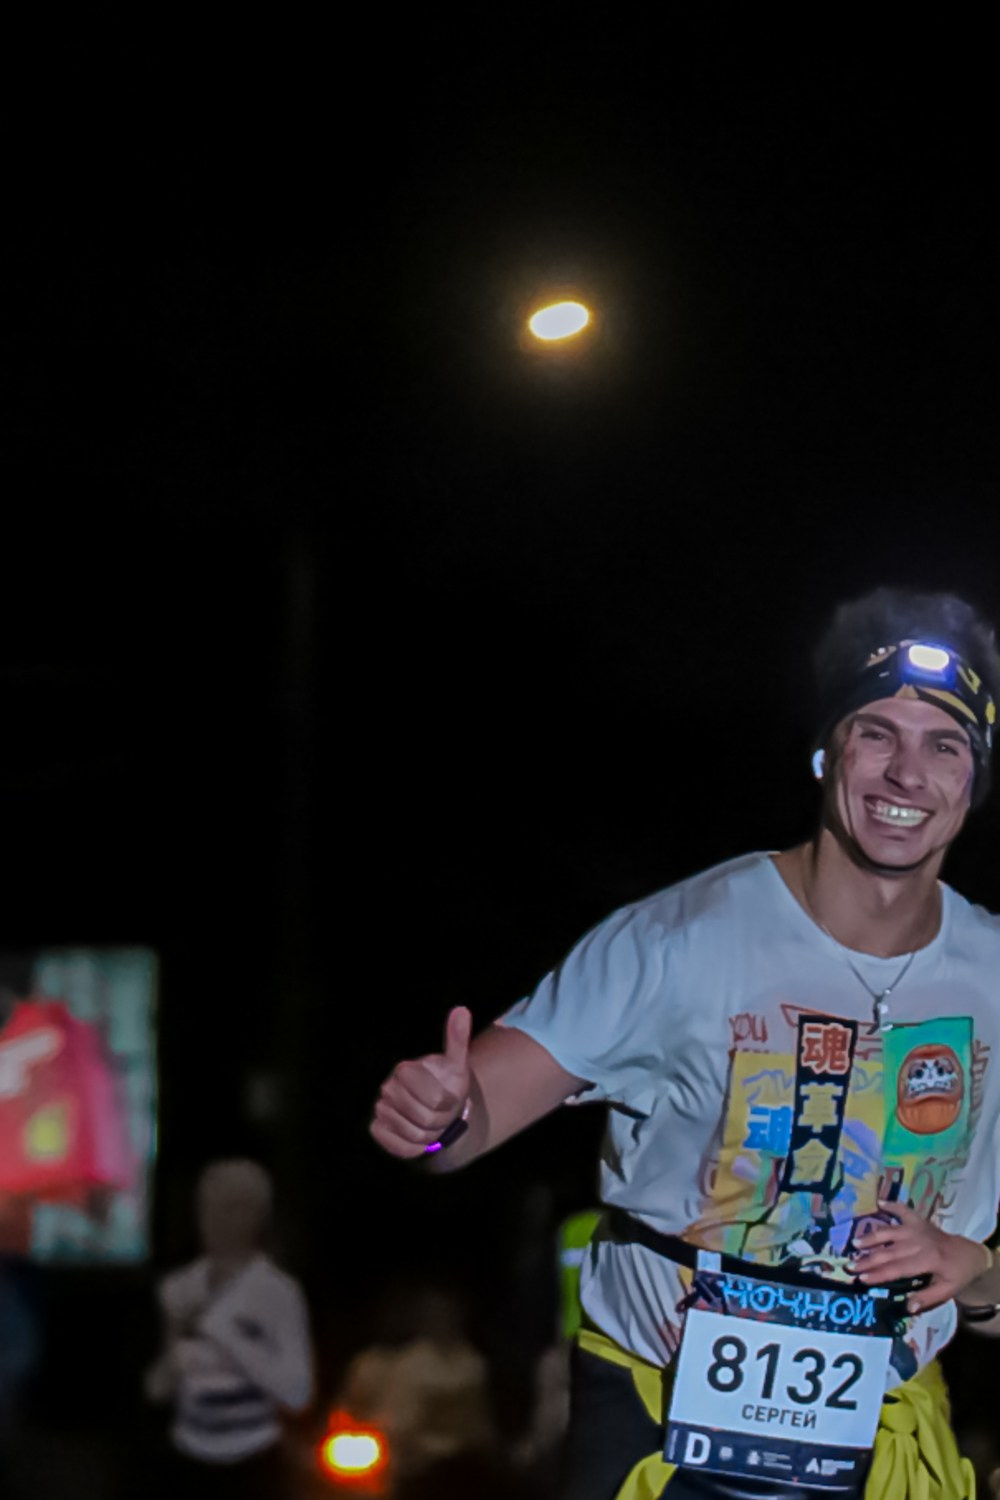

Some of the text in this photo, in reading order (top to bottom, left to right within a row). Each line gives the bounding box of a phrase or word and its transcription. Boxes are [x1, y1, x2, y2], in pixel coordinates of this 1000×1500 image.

[802, 1022, 854, 1075] 魂
[706, 1334, 864, 1411] 8132
[741, 1403, 817, 1430] СЕРГЕЙ
[684, 1431, 712, 1465] D
